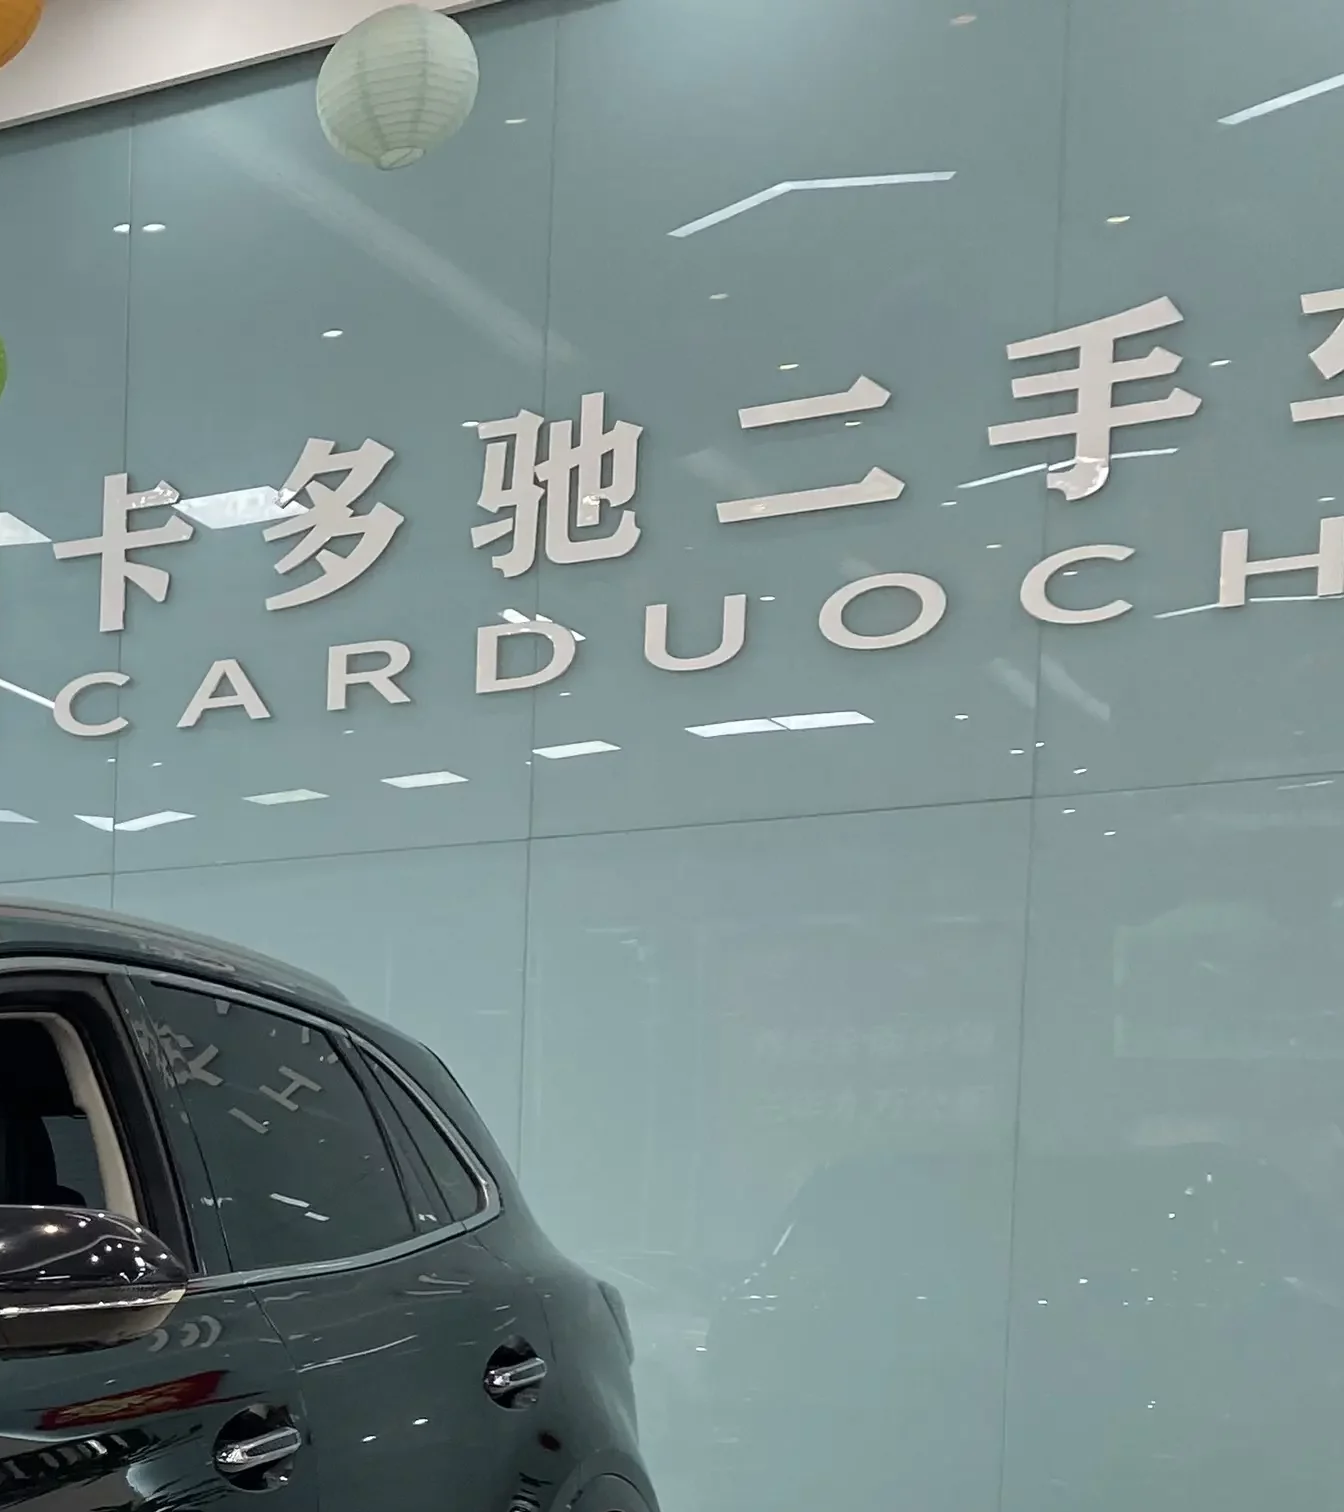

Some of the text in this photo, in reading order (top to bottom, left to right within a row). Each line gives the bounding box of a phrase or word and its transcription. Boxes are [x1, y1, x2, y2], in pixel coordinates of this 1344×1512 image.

[52, 288, 1344, 633] 卡多驰二手
